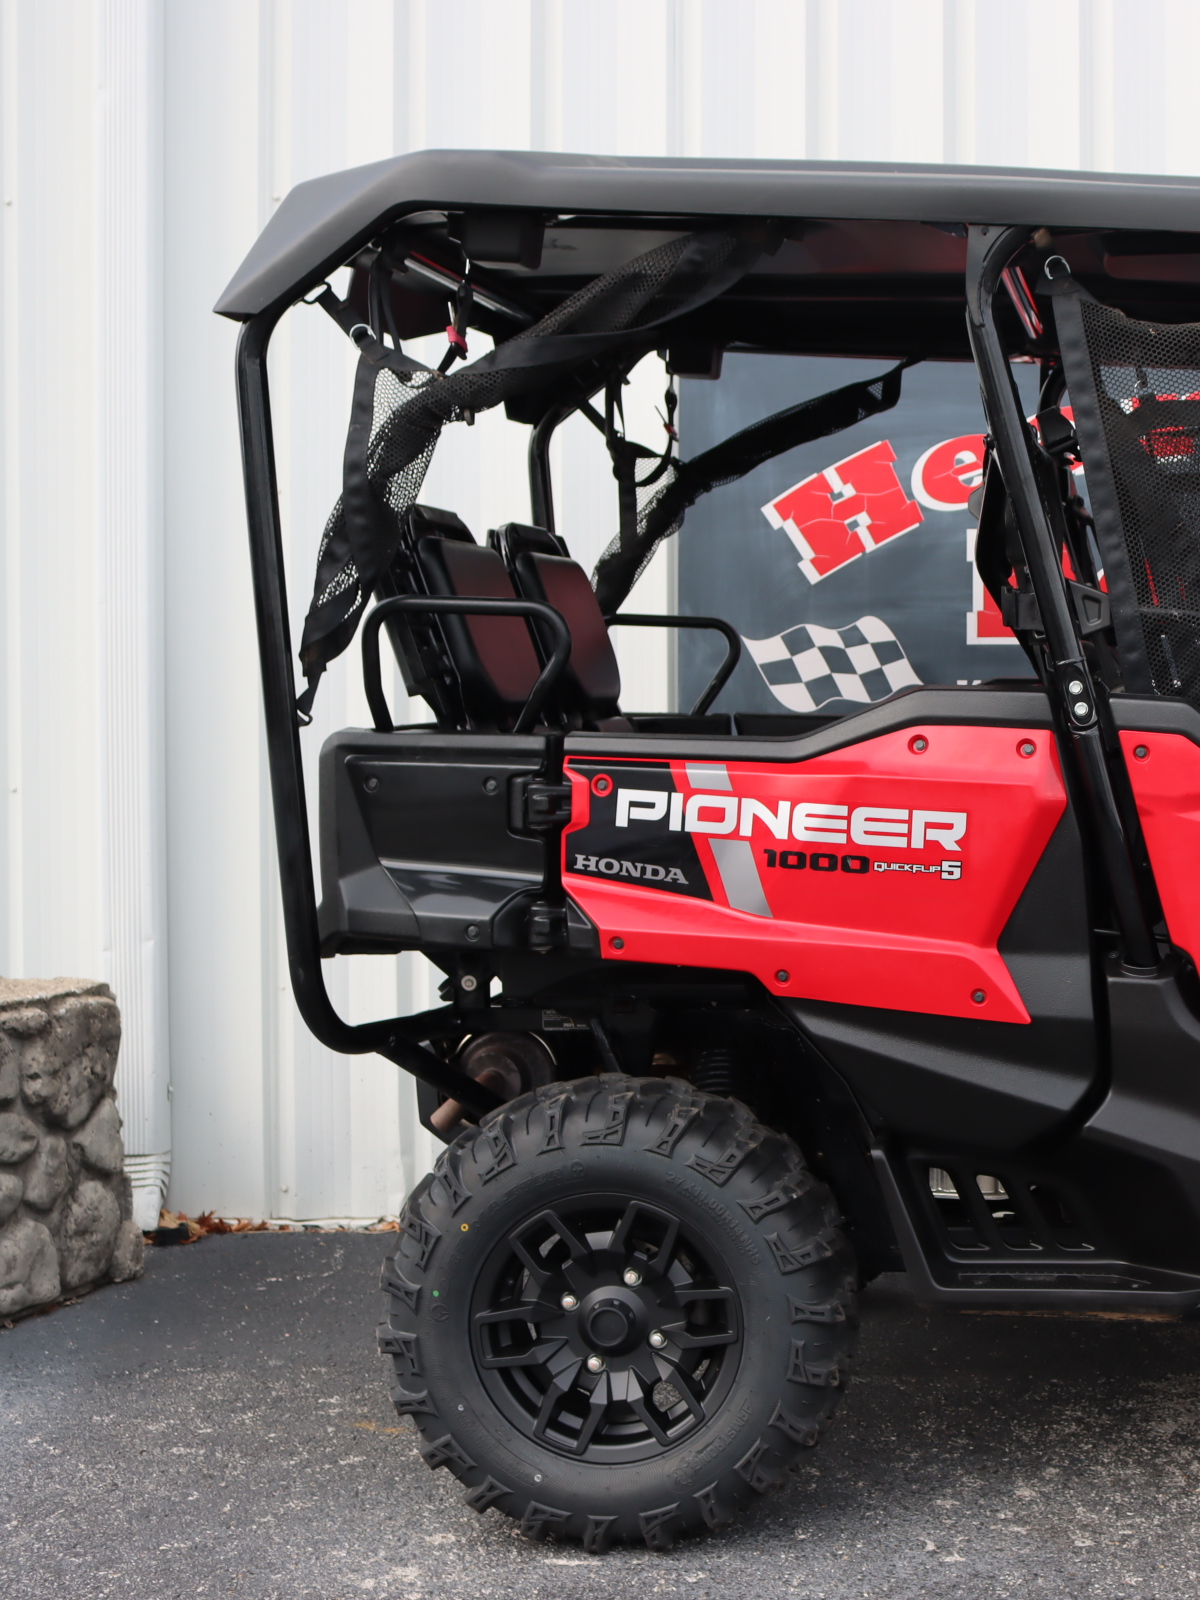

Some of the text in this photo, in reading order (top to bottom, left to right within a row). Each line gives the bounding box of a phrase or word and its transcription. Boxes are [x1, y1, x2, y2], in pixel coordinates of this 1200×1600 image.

[615, 788, 967, 851] PIONEER
[574, 854, 689, 884] HONDA
[764, 849, 870, 874] 1000
